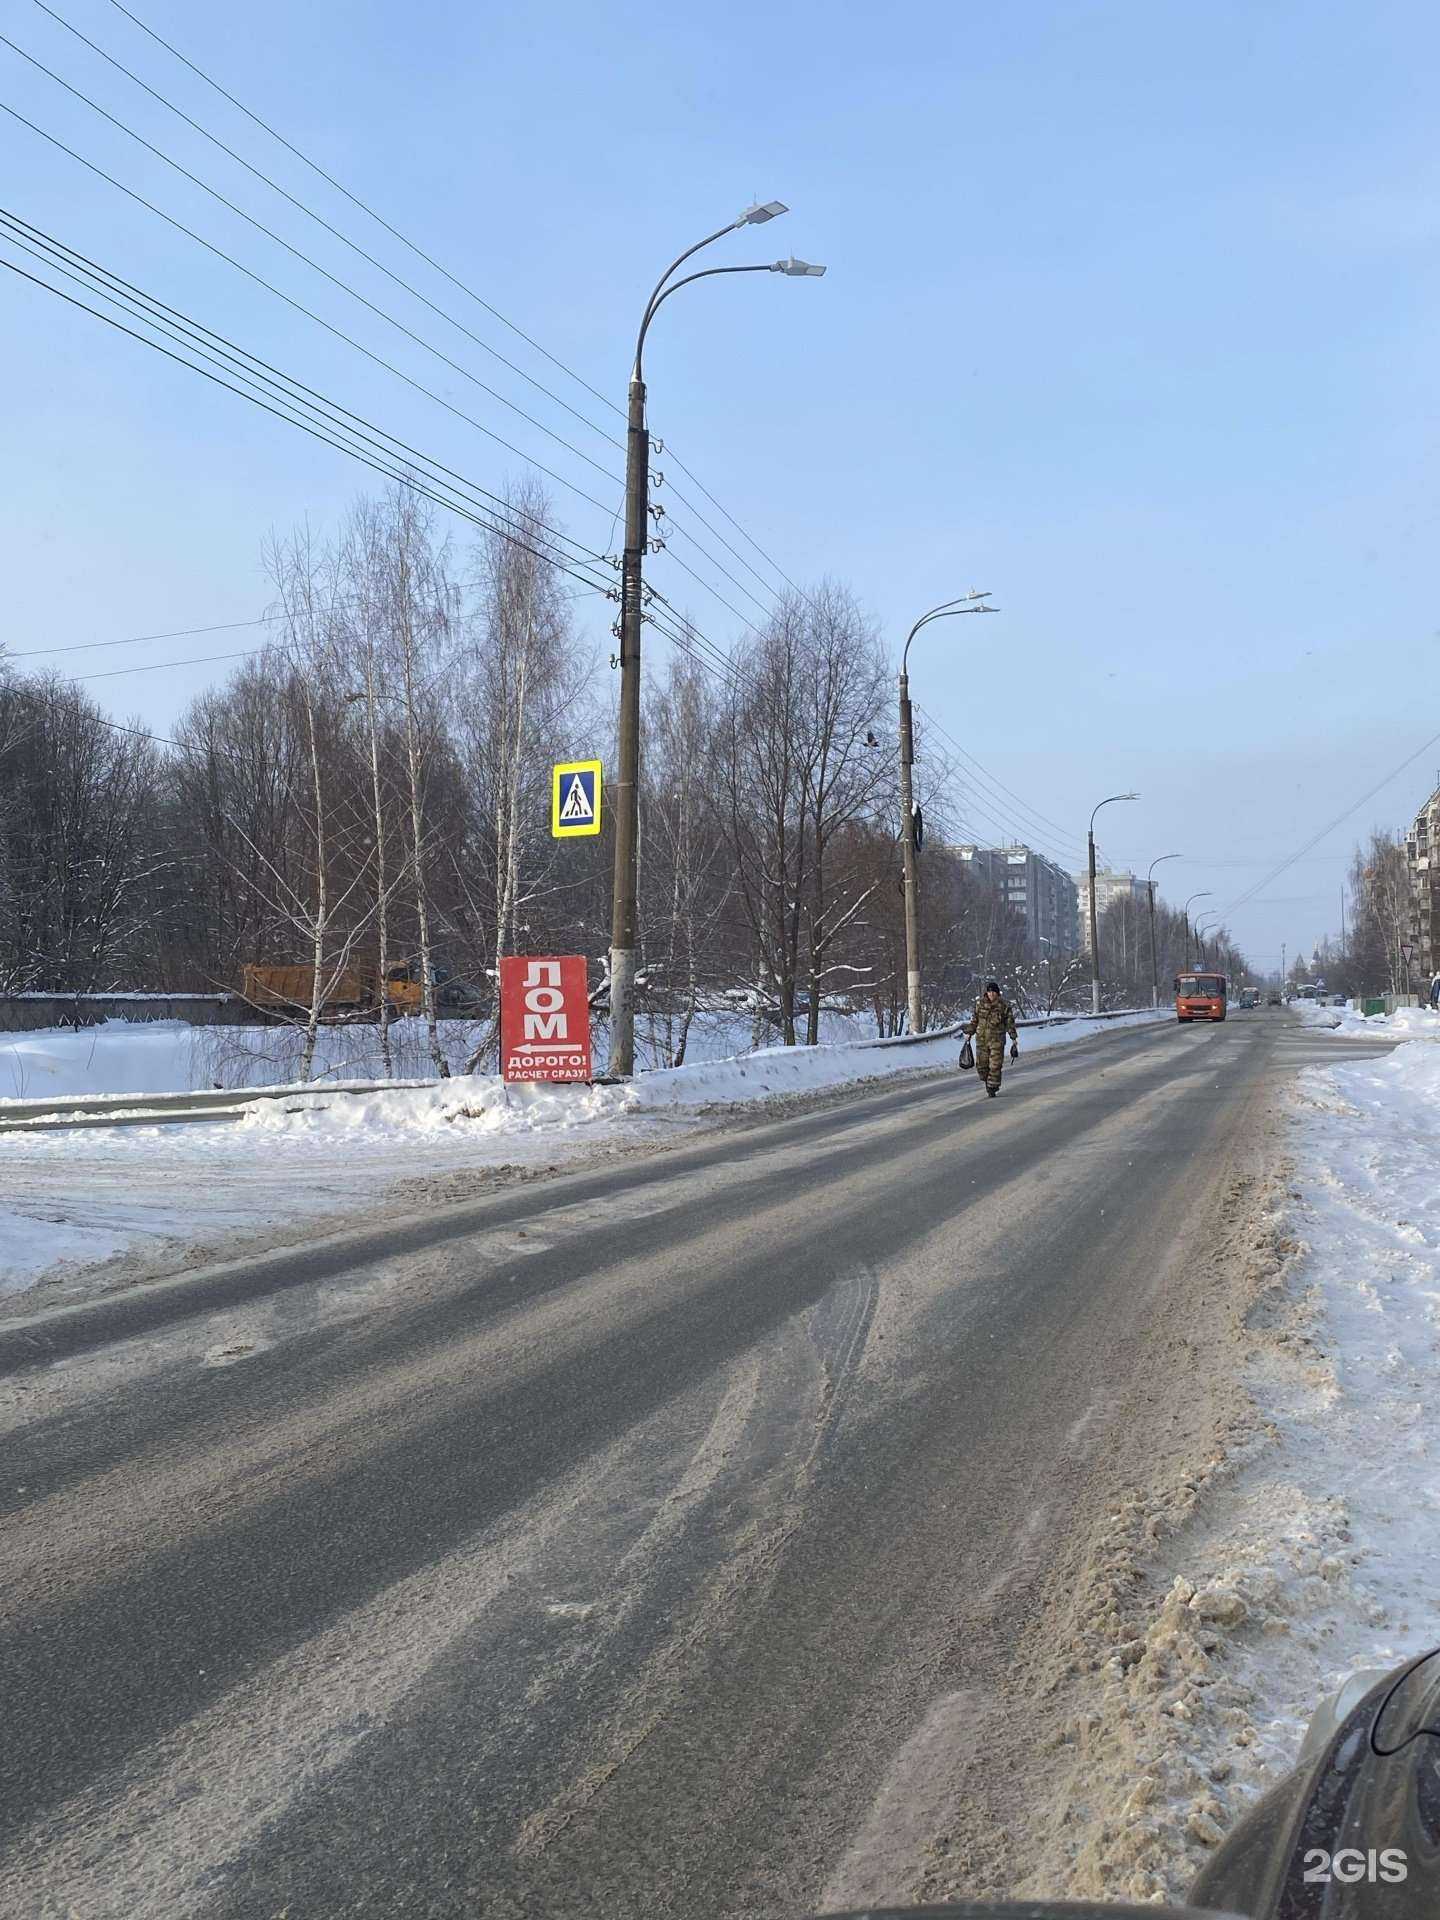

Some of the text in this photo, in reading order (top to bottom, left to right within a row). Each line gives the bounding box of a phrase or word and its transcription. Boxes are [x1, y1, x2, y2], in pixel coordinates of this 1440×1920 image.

[522, 961, 568, 1040] ЛОМ
[507, 1055, 587, 1069] ДОРОГО!
[508, 1069, 587, 1080] РАСЧЕТ СРАЗУ!
